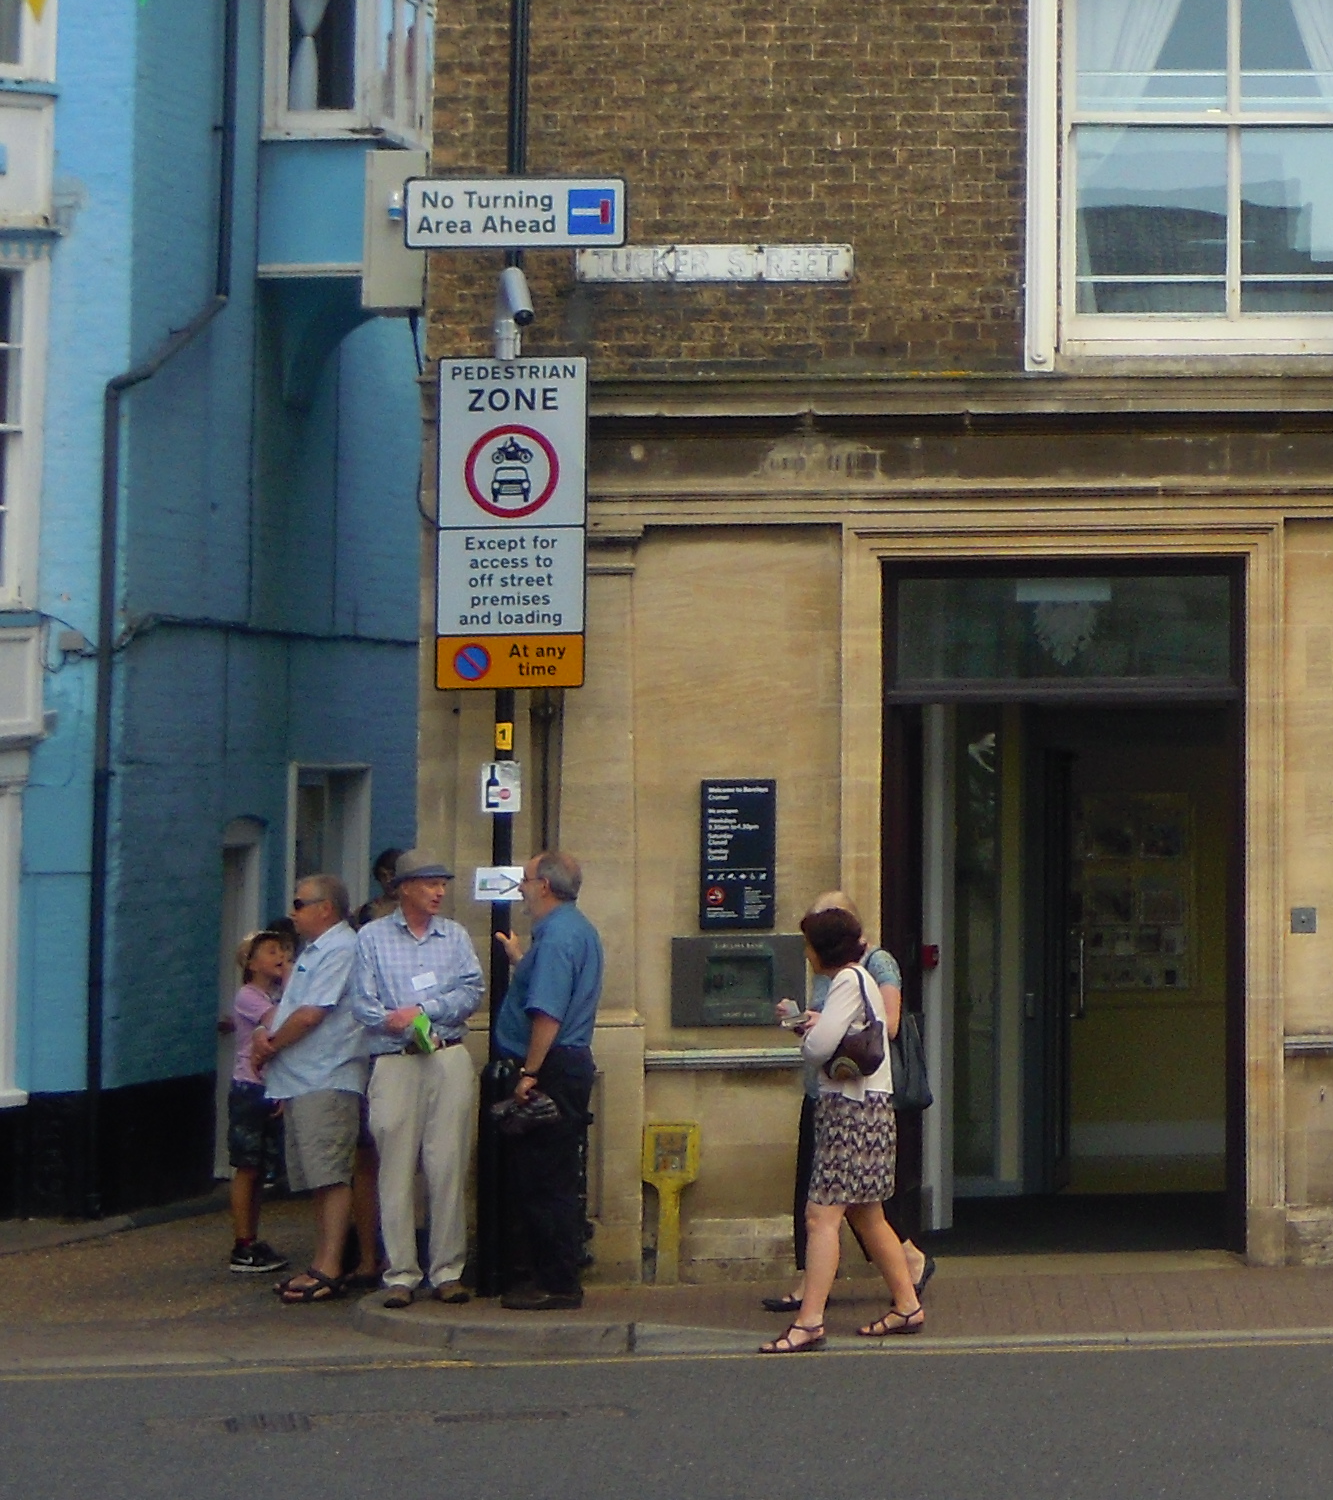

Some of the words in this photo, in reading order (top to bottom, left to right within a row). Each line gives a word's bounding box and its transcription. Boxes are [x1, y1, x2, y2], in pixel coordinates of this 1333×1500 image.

[421, 190, 454, 209] No
[463, 190, 554, 212] Turning
[416, 215, 473, 234] Area
[482, 214, 556, 234] Ahead
[592, 249, 709, 279] TUCKER
[726, 248, 839, 278] STREET
[451, 364, 577, 381] PEDESTRIAN
[467, 387, 559, 412] ZONE
[464, 535, 526, 552] Except
[532, 535, 558, 550] for
[469, 556, 529, 569] access
[535, 554, 553, 568] to
[468, 573, 494, 588] off
[500, 573, 553, 587] street
[470, 592, 551, 609] premises
[459, 611, 491, 626] and
[498, 610, 563, 626] loading
[509, 643, 529, 658] At
[535, 646, 566, 660] any
[518, 661, 557, 676] time
[498, 728, 506, 741] 1
